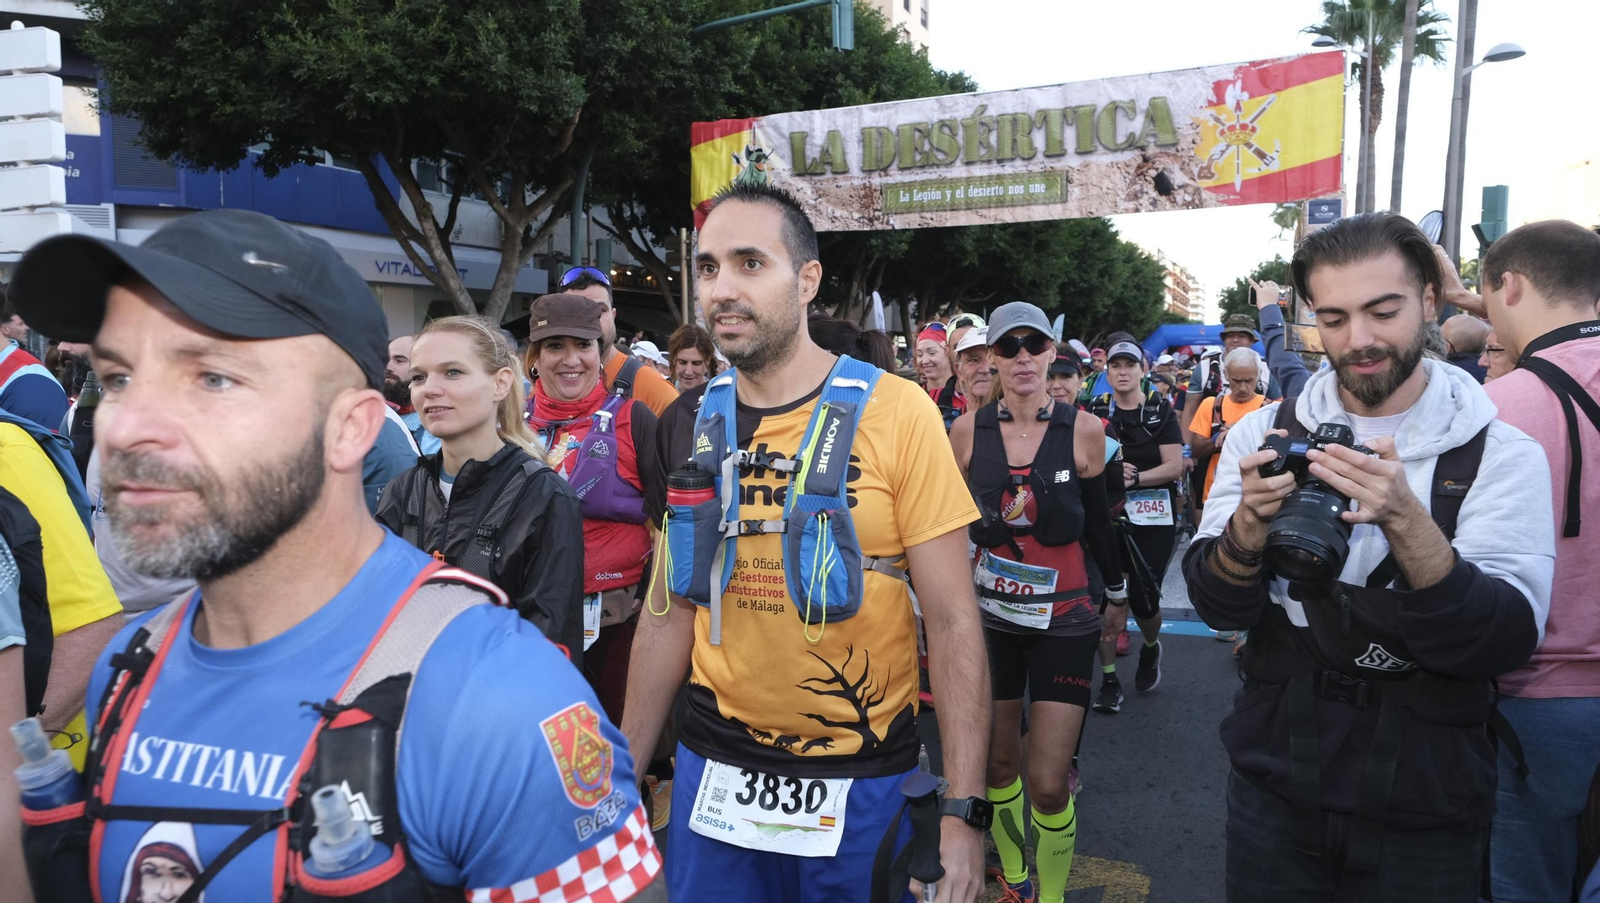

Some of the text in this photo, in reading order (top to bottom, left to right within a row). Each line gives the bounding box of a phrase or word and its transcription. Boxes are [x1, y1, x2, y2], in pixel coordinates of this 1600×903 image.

[790, 96, 1179, 175] LA DESÉRTICA
[899, 183, 1046, 203] La Legión y el desierto nos une
[816, 417, 841, 474] AONIJIE
[1135, 500, 1165, 514] 2645
[734, 557, 785, 570] gio Oficial
[595, 571, 623, 580] dobuss
[740, 571, 785, 584] Gestores
[724, 583, 785, 598] inistrativos
[736, 597, 785, 615] de Málaga
[697, 766, 713, 812] MARCHA INDIVIDUAL
[735, 769, 828, 815] 3830
[574, 789, 628, 842] BAZA
[707, 805, 723, 816] BUS
